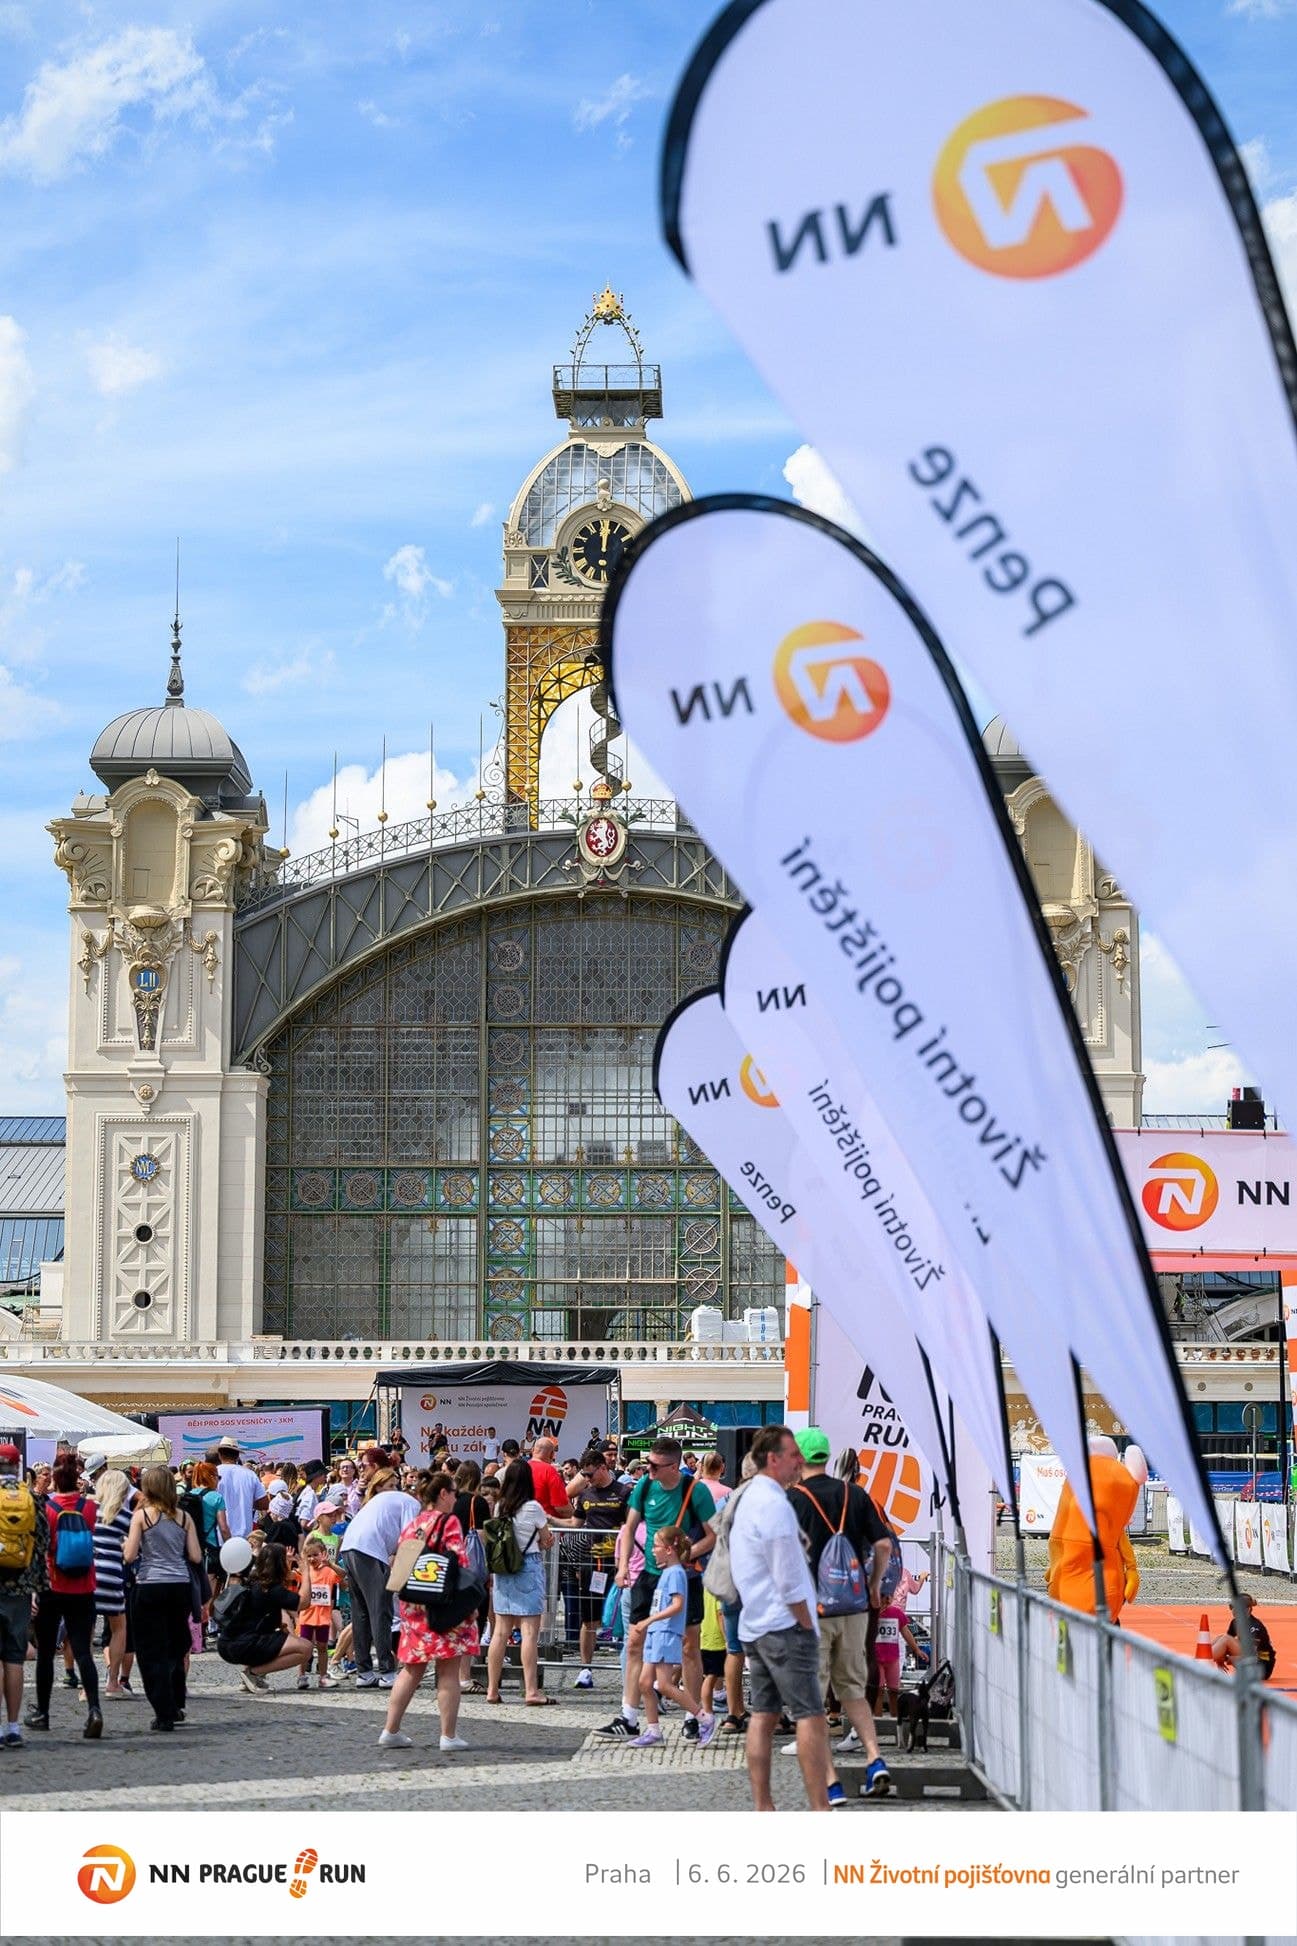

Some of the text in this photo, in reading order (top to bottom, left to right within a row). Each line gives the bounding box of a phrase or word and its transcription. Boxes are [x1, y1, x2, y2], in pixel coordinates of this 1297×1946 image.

[1236, 1180, 1290, 1206] NN
[204, 1419, 219, 1427] PRO
[220, 1418, 235, 1426] SOS
[527, 1416, 563, 1438] NN
[657, 1424, 708, 1433] NIGHT
[657, 1431, 708, 1439] RUN
